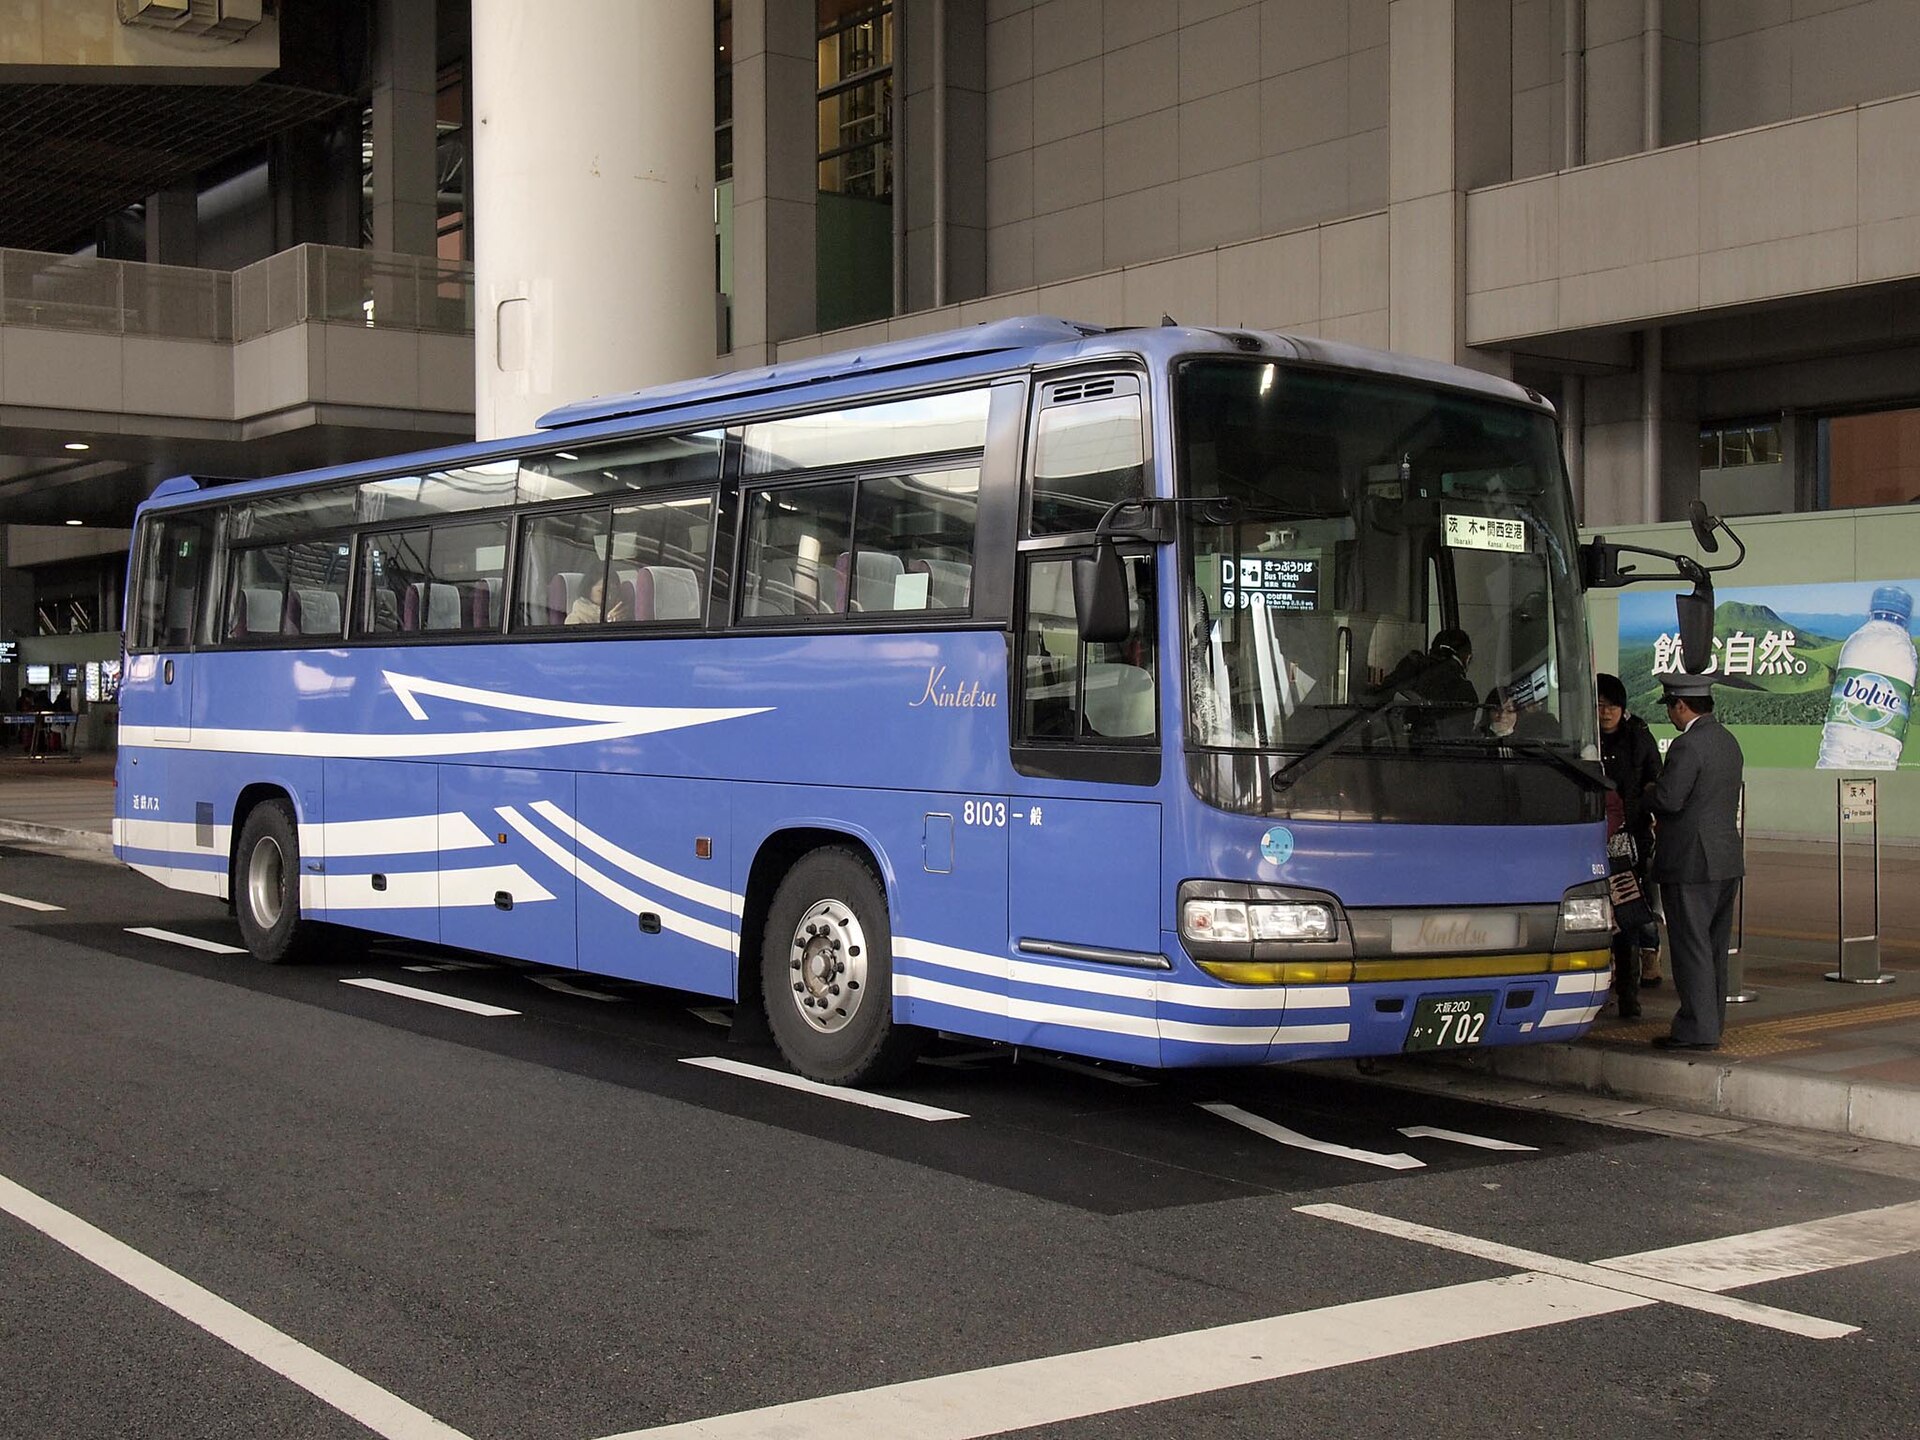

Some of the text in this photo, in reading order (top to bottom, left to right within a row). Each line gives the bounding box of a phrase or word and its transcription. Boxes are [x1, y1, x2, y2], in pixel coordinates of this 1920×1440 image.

[1487, 520, 1523, 539] 関西空港
[1487, 540, 1504, 549] Kansai
[1264, 561, 1313, 573] きっぷうりば
[1264, 572, 1300, 582] Bus Tickets
[909, 666, 997, 707] Kintetsu
[1843, 678, 1900, 709] Volvic
[963, 800, 1006, 827] 8103
[1414, 915, 1488, 946] Kintetsu
